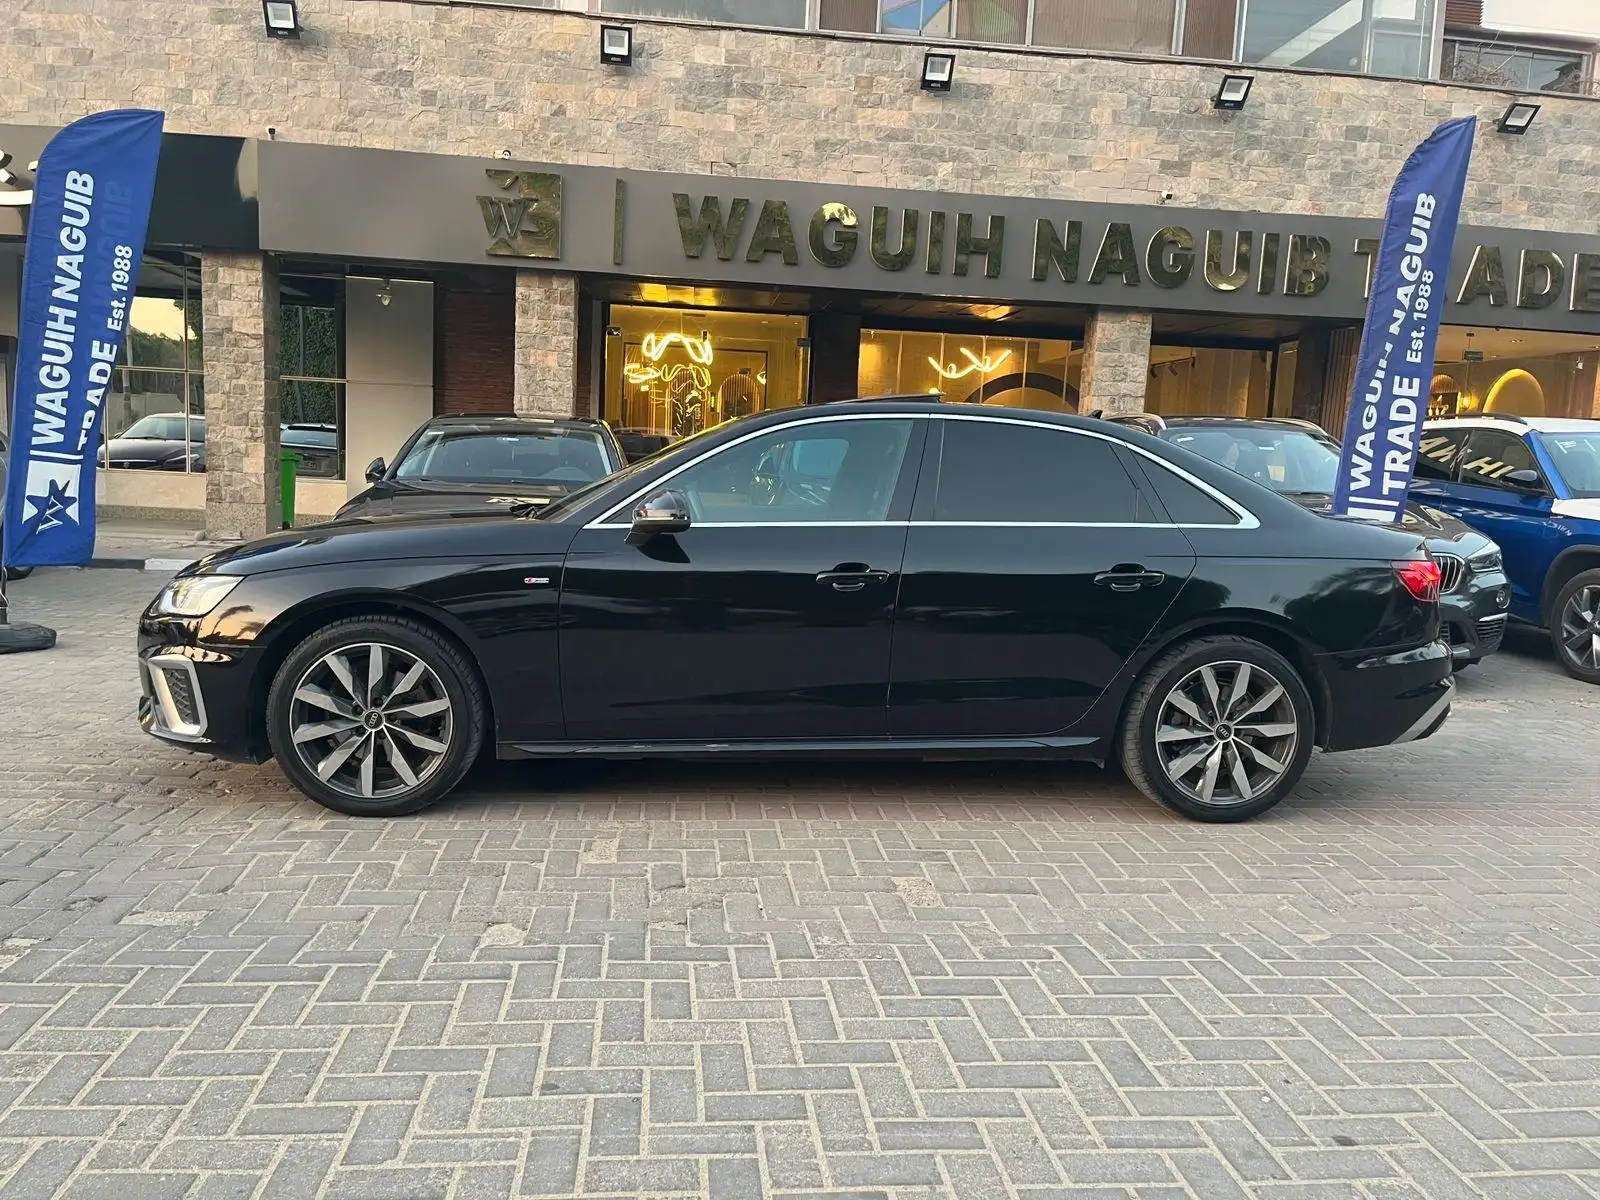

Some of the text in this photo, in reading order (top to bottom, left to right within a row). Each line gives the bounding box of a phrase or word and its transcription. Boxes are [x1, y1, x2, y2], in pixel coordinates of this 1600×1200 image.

[31, 170, 94, 446] WAGUIH NAGUIB
[106, 296, 128, 332] Est.
[111, 244, 133, 292] 1988
[672, 192, 1600, 312] WAGUIH NAGUIB TADE
[1388, 192, 1436, 336] NAGUIB
[1381, 269, 1434, 497] TRADE Est. 1988
